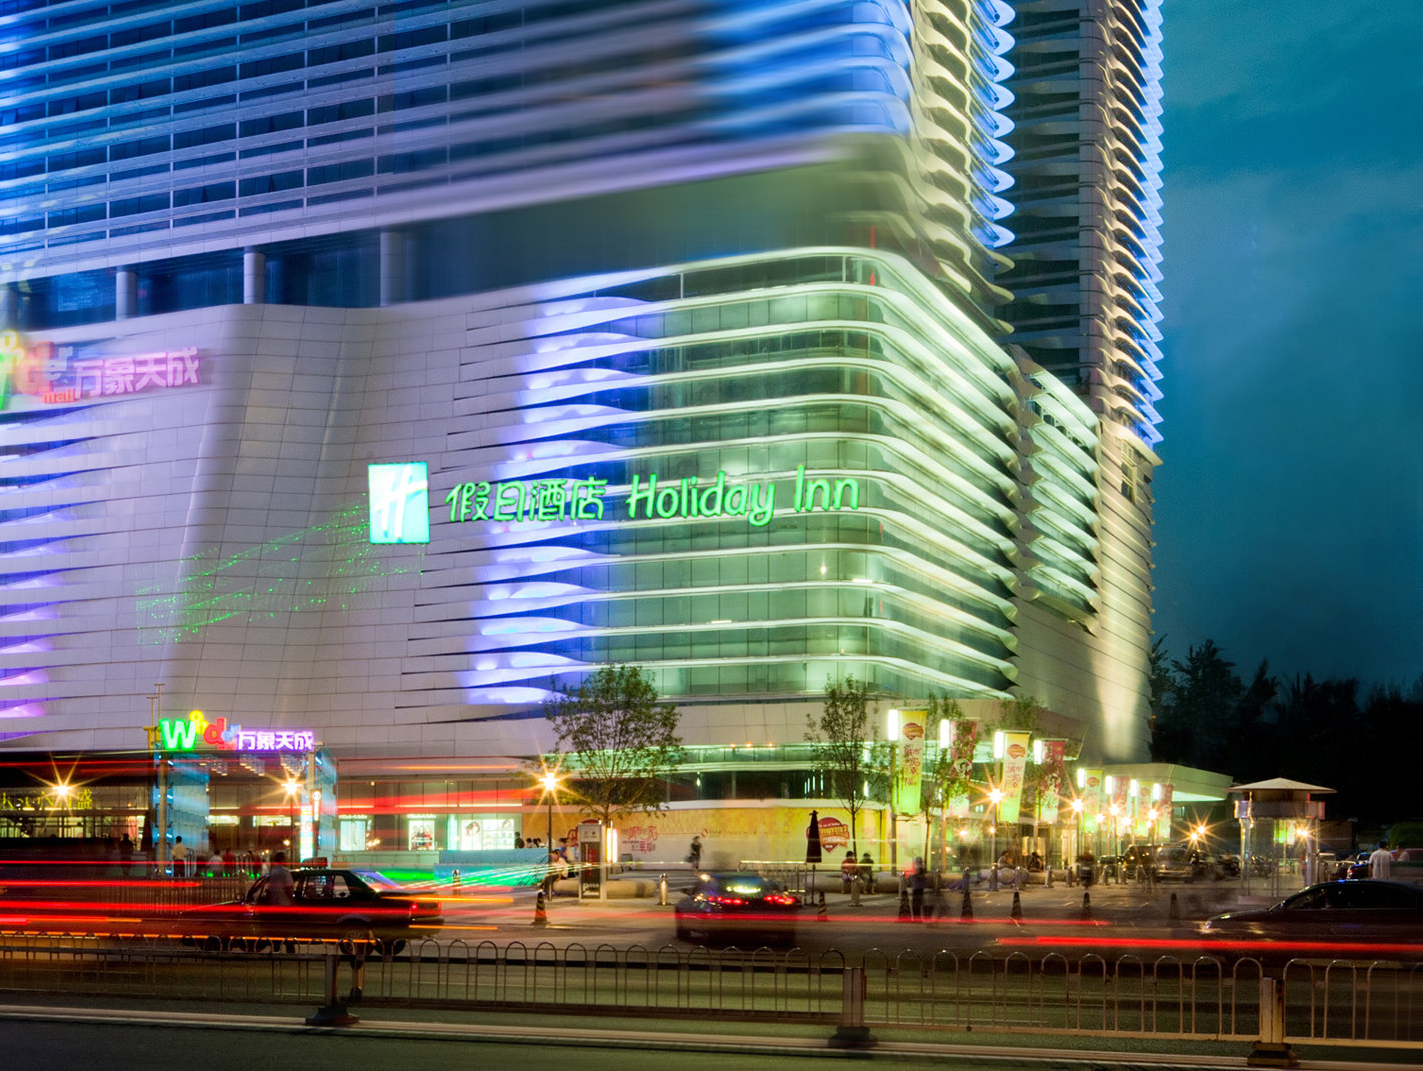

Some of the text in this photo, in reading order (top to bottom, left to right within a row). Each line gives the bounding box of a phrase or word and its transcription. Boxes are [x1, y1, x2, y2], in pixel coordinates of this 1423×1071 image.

[41, 388, 75, 404] mall
[73, 346, 201, 399] 万象天成
[444, 476, 608, 523] 假日酒店
[625, 464, 860, 527] Holiday Inn
[237, 731, 314, 751] 万象天成
